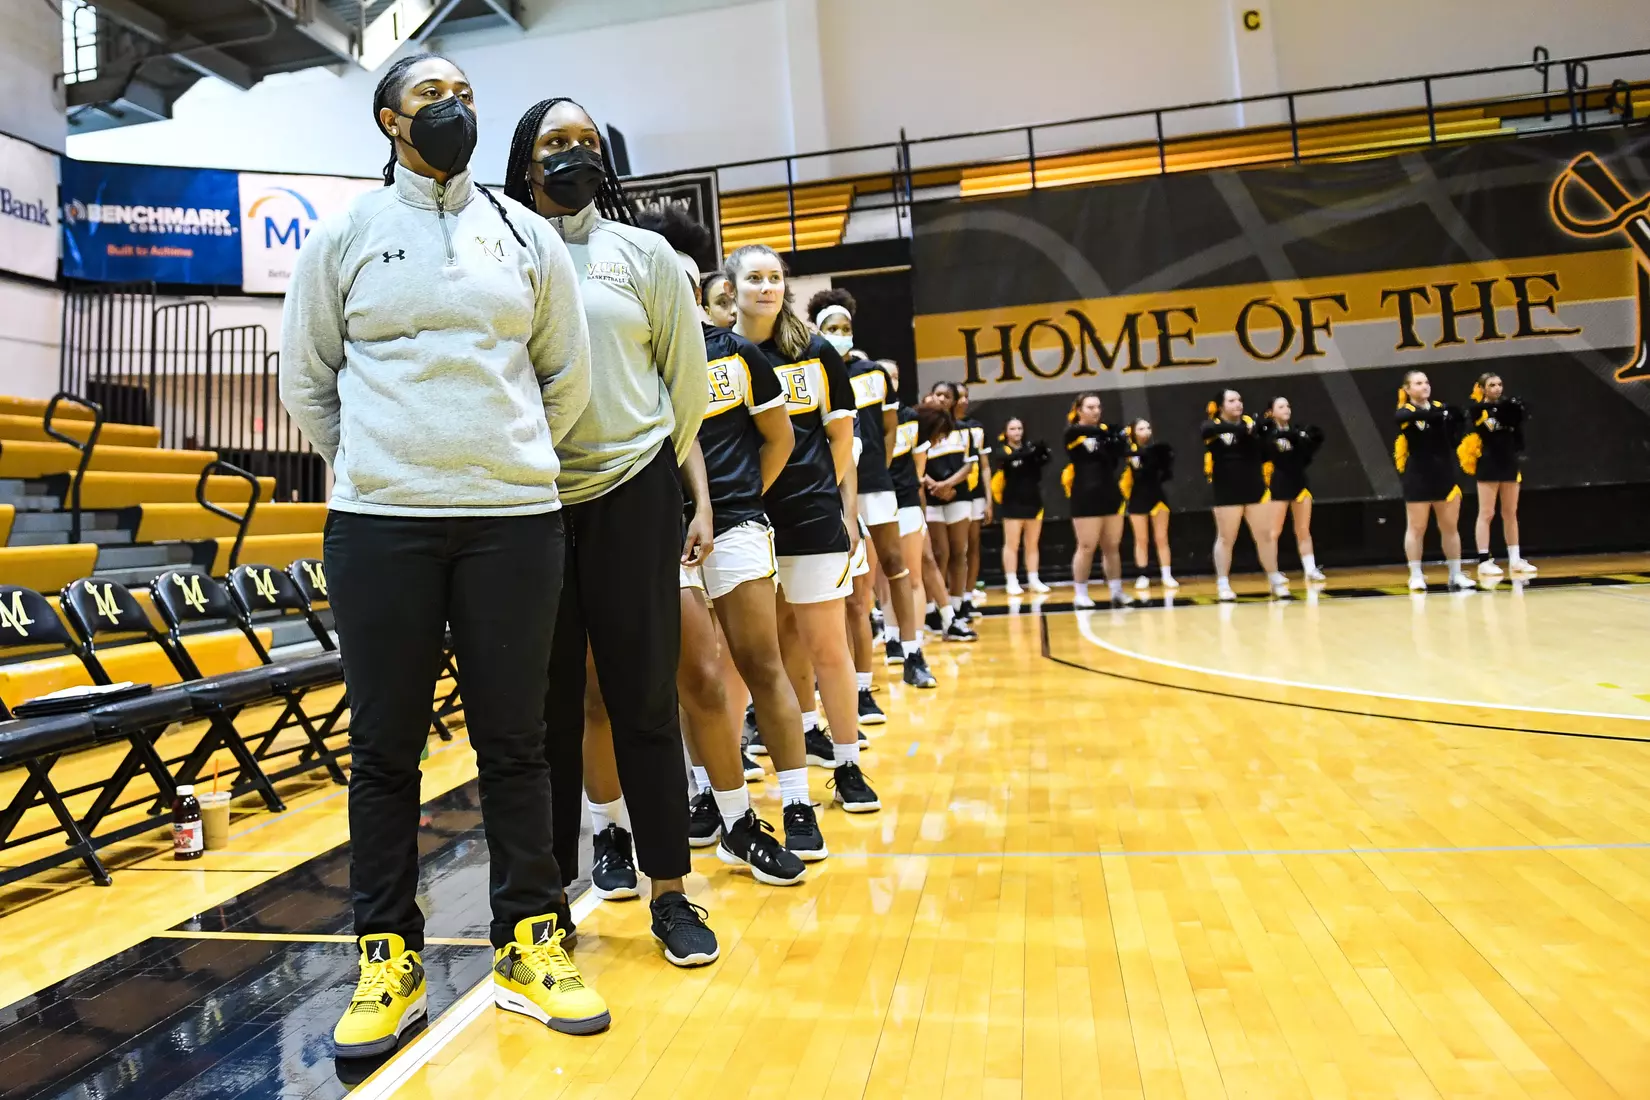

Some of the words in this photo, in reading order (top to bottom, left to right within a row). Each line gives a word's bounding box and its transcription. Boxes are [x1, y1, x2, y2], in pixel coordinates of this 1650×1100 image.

[1244, 10, 1260, 31] C
[0, 187, 51, 227] Bank
[87, 203, 231, 228] BENCHMARK
[265, 216, 310, 249] M
[957, 305, 1218, 385] HOME
[1234, 293, 1350, 362] OF
[1379, 272, 1582, 351] THE
